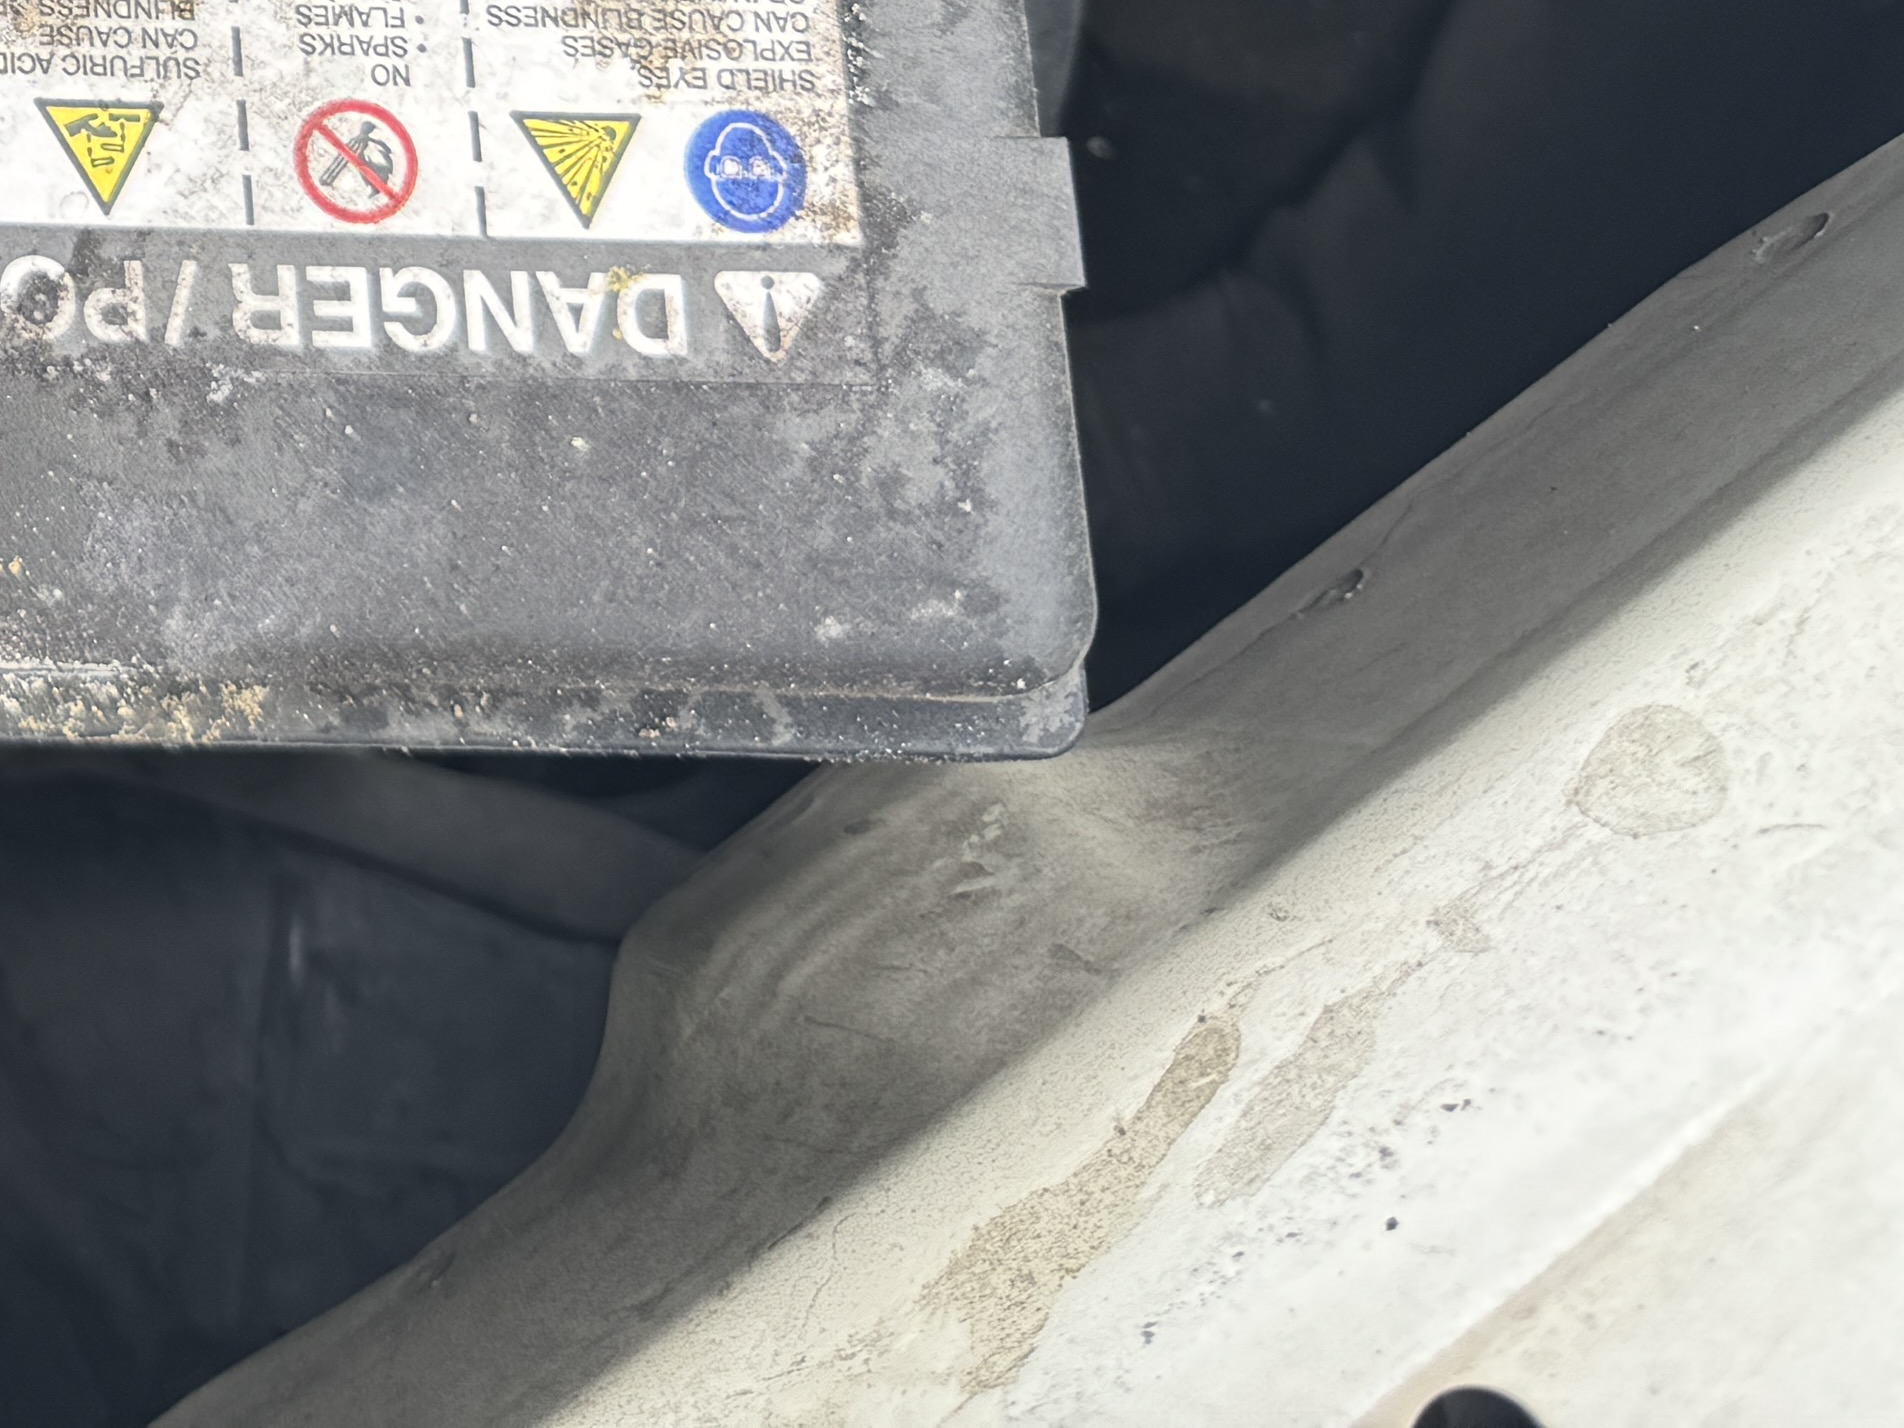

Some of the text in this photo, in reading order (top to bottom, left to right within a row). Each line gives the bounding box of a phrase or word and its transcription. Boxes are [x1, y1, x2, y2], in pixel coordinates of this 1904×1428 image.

[294, 3, 404, 29] FLAMES
[485, 4, 809, 32] CAN CAUSE BLINDNESS
[38, 24, 198, 49] CAN CAUSE
[299, 33, 408, 57] SPARKS
[561, 35, 814, 62] EXPLOSIVE GASES
[61, 53, 201, 78] SULFURIC
[370, 64, 411, 87] NO
[717, 68, 816, 93] SHIELD
[227, 261, 689, 358] DANGER
